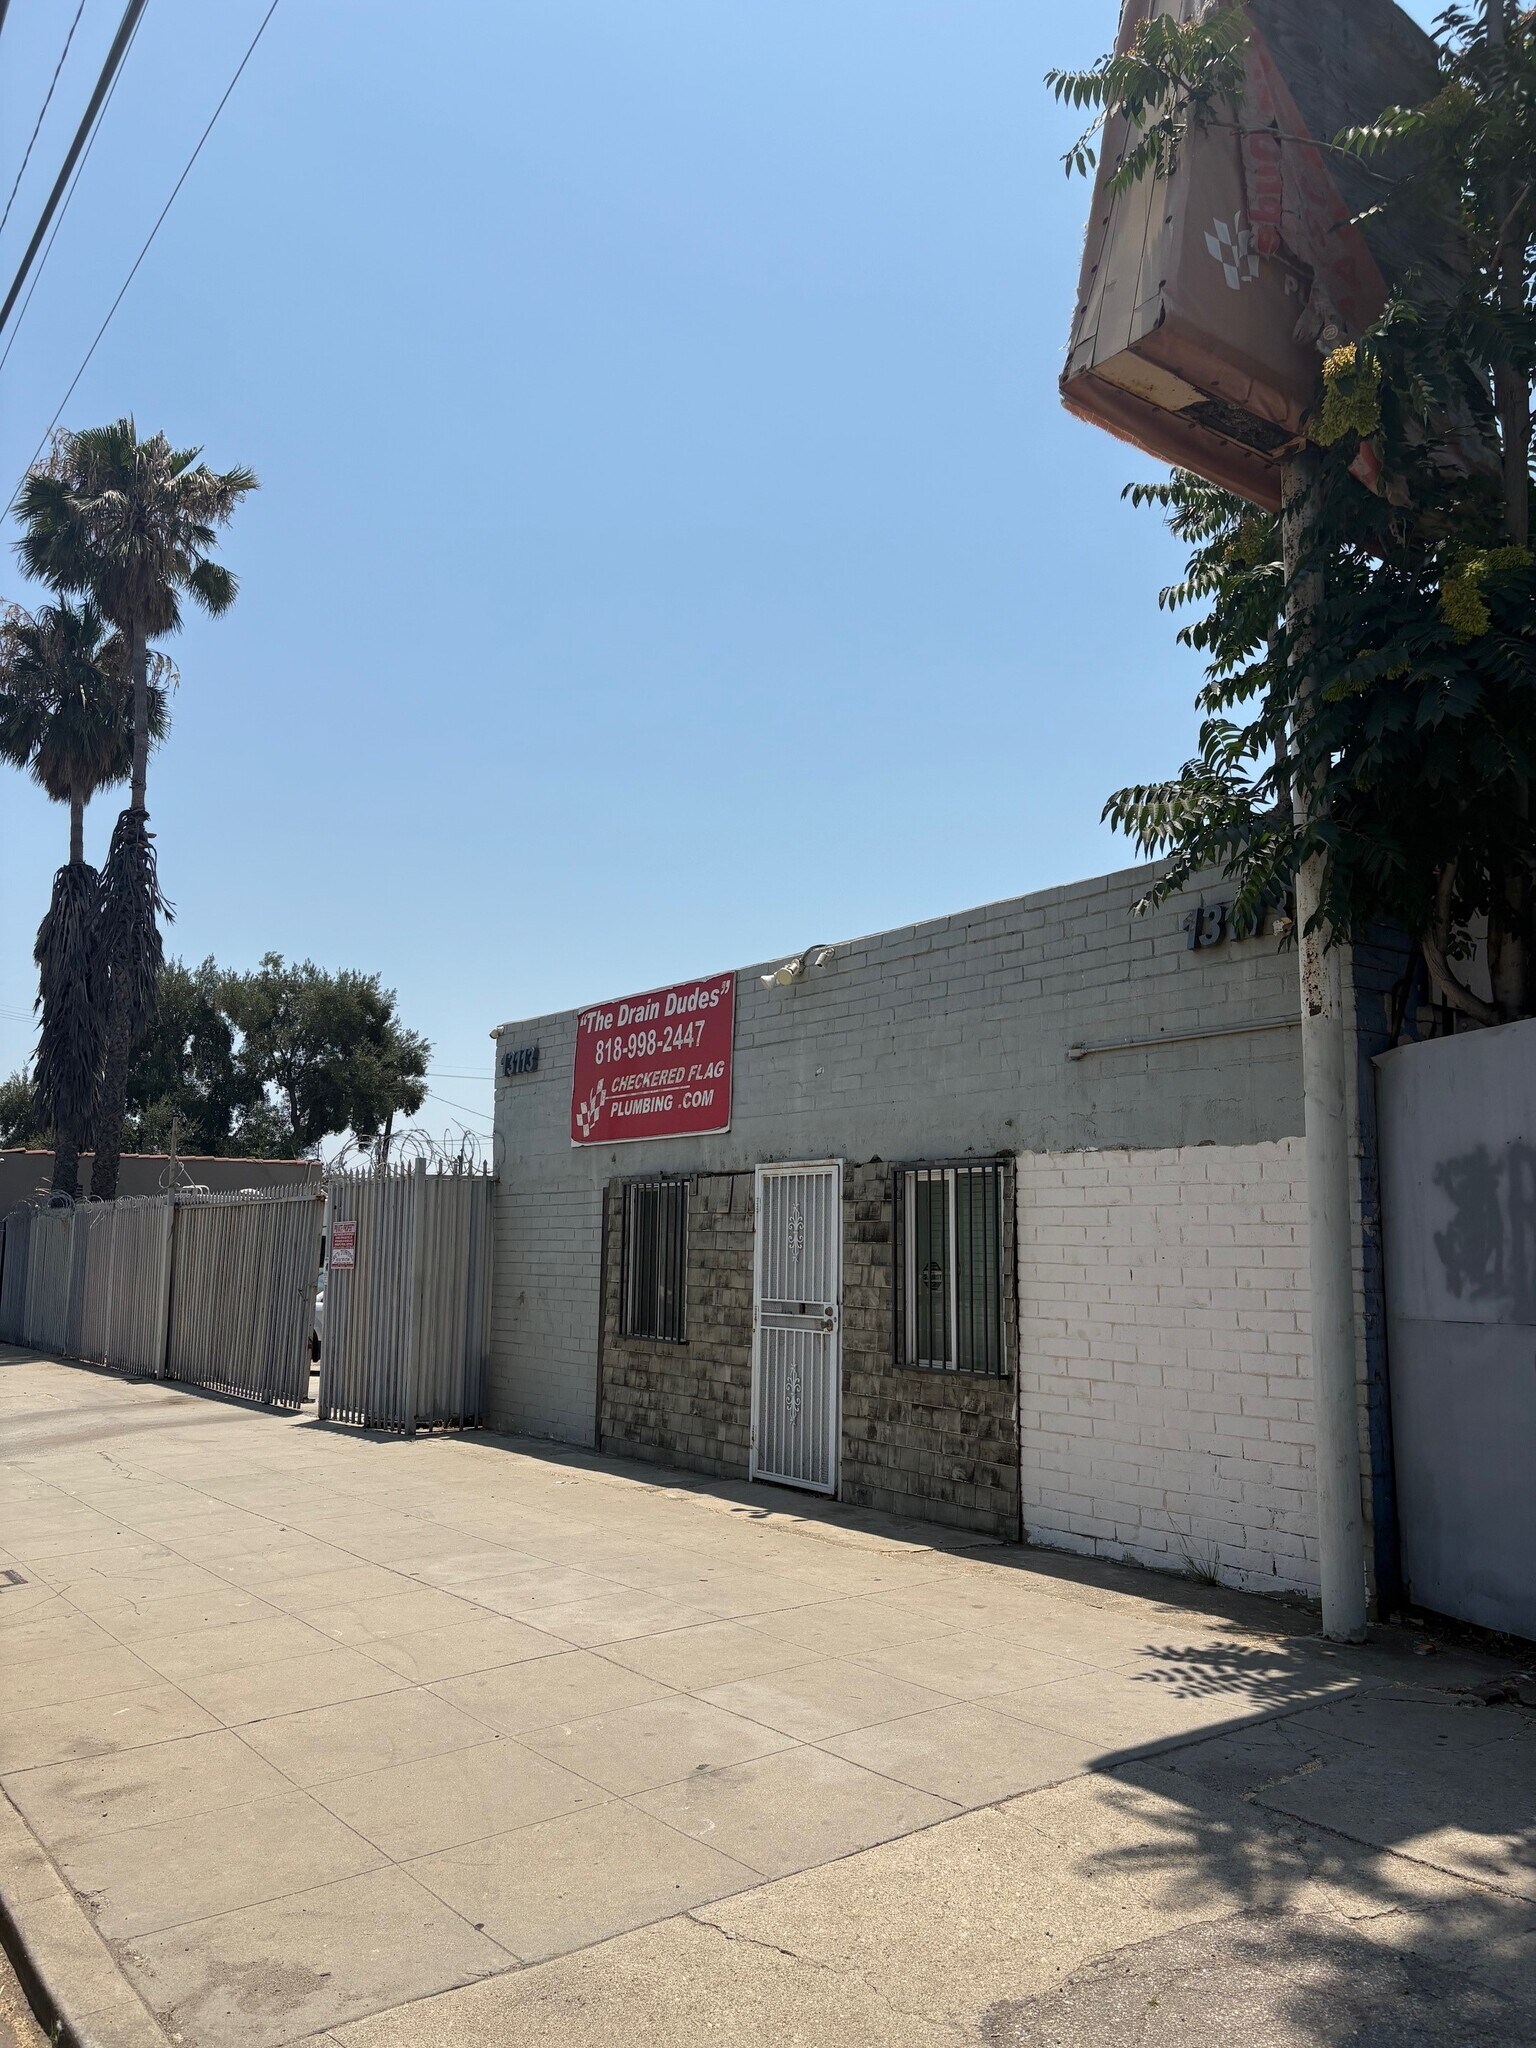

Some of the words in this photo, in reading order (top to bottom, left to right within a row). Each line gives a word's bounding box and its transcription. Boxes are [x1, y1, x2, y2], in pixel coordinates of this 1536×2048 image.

[617, 998, 660, 1027] Drain
[595, 1019, 706, 1065] 818-998-2447
[611, 1066, 686, 1093] CHECKERED
[687, 1060, 725, 1082] FLAG
[610, 1095, 673, 1118] PLUMBING
[678, 1089, 715, 1109] .COM
